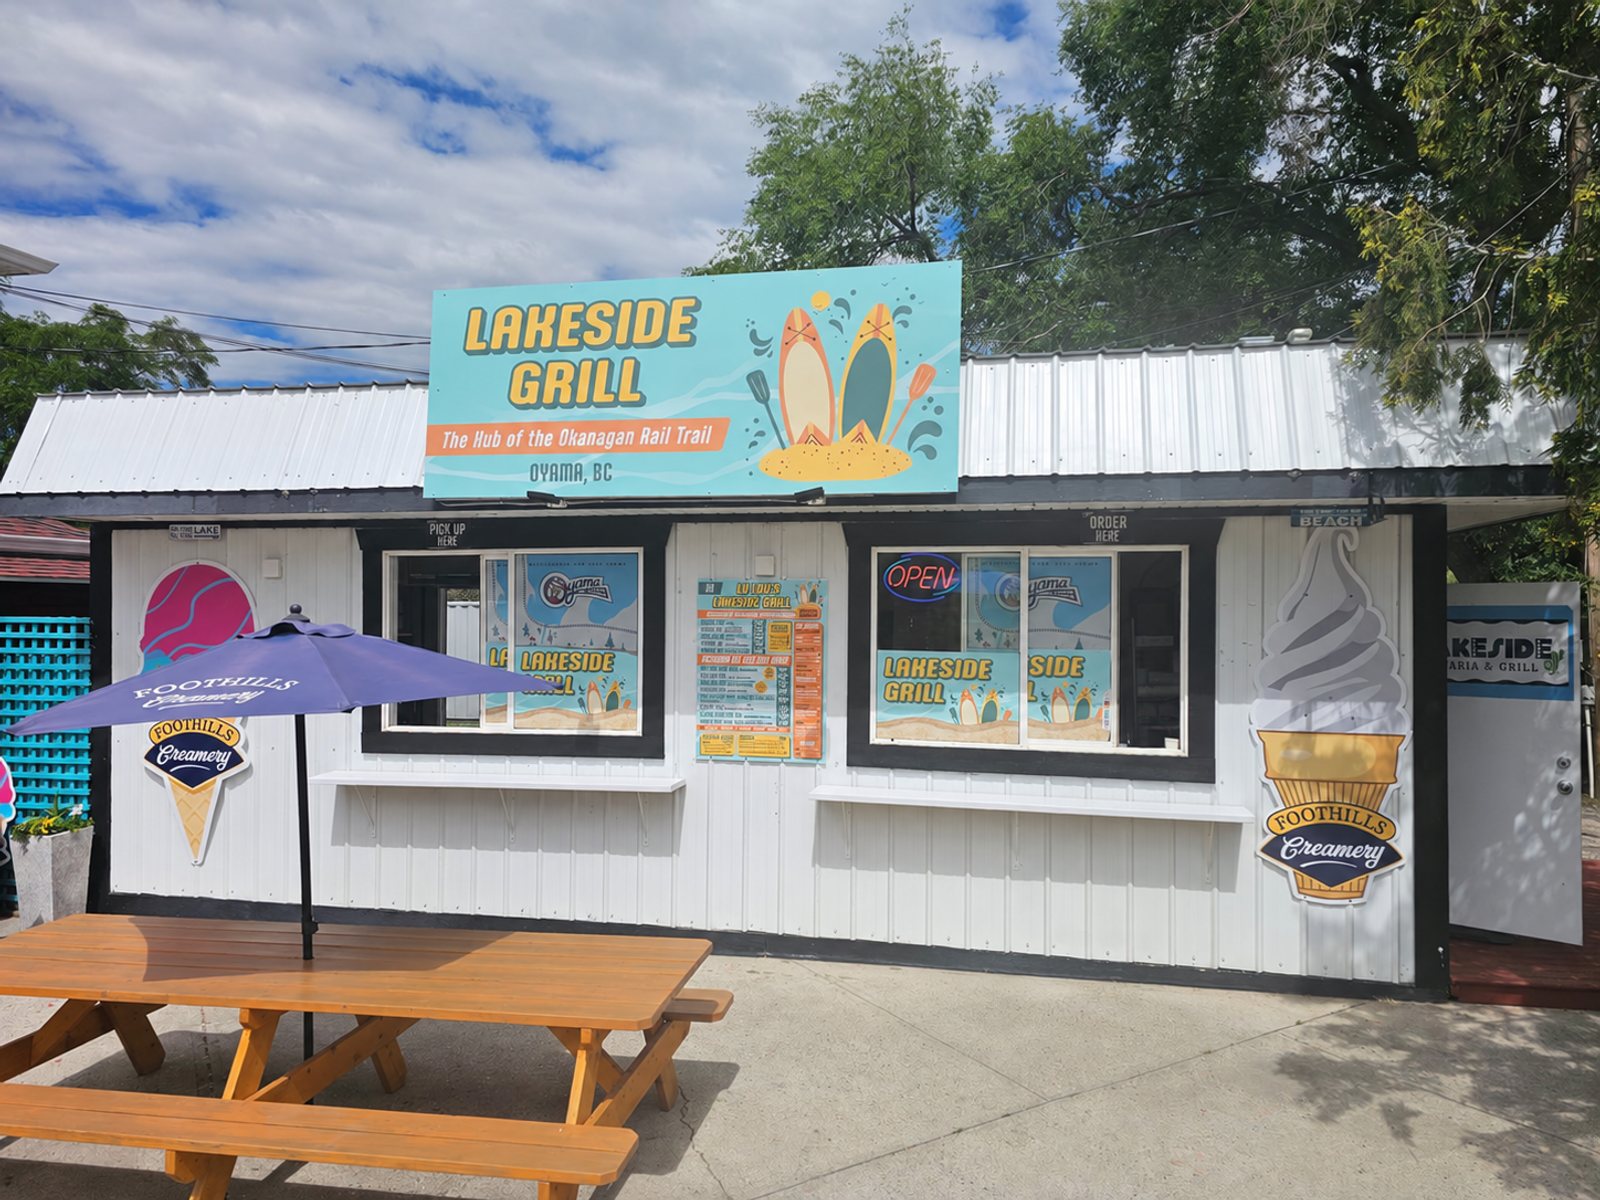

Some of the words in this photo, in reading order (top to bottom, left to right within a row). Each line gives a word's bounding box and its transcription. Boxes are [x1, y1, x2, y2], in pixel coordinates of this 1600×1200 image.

[464, 296, 701, 355] LAKESIDE
[508, 356, 646, 410] GRILL
[442, 431, 468, 449] The
[473, 430, 501, 448] Hub
[506, 429, 524, 447] of
[528, 428, 553, 447] the
[558, 427, 634, 450] Okanagan
[640, 427, 671, 445] Rail
[677, 425, 712, 444] Trail
[530, 462, 587, 485] OYAMA,
[593, 463, 613, 482] BC
[194, 526, 220, 534] LAKE
[429, 523, 451, 535] PICK
[453, 523, 466, 535] UP
[1090, 515, 1127, 529] ORDER
[1300, 516, 1362, 527] BEACH
[437, 535, 458, 547] HERE
[1095, 529, 1120, 542] HERE
[887, 565, 955, 589] OPEN
[1447, 637, 1552, 659] KESIDE
[520, 651, 615, 672] LAKESIDE
[884, 656, 993, 681] LAKESIDE
[1028, 655, 1085, 678] SIDE
[1448, 661, 1479, 671] ARIA
[1484, 662, 1493, 671] &
[1499, 662, 1539, 672] GRILL
[133, 676, 299, 699] FOOTHILLS
[884, 681, 946, 704] GRILL
[154, 718, 235, 742] FOOTHILLS
[156, 744, 232, 771] Creamery
[1274, 806, 1388, 835] FOOTHILLS
[1280, 836, 1386, 869] Creamery
